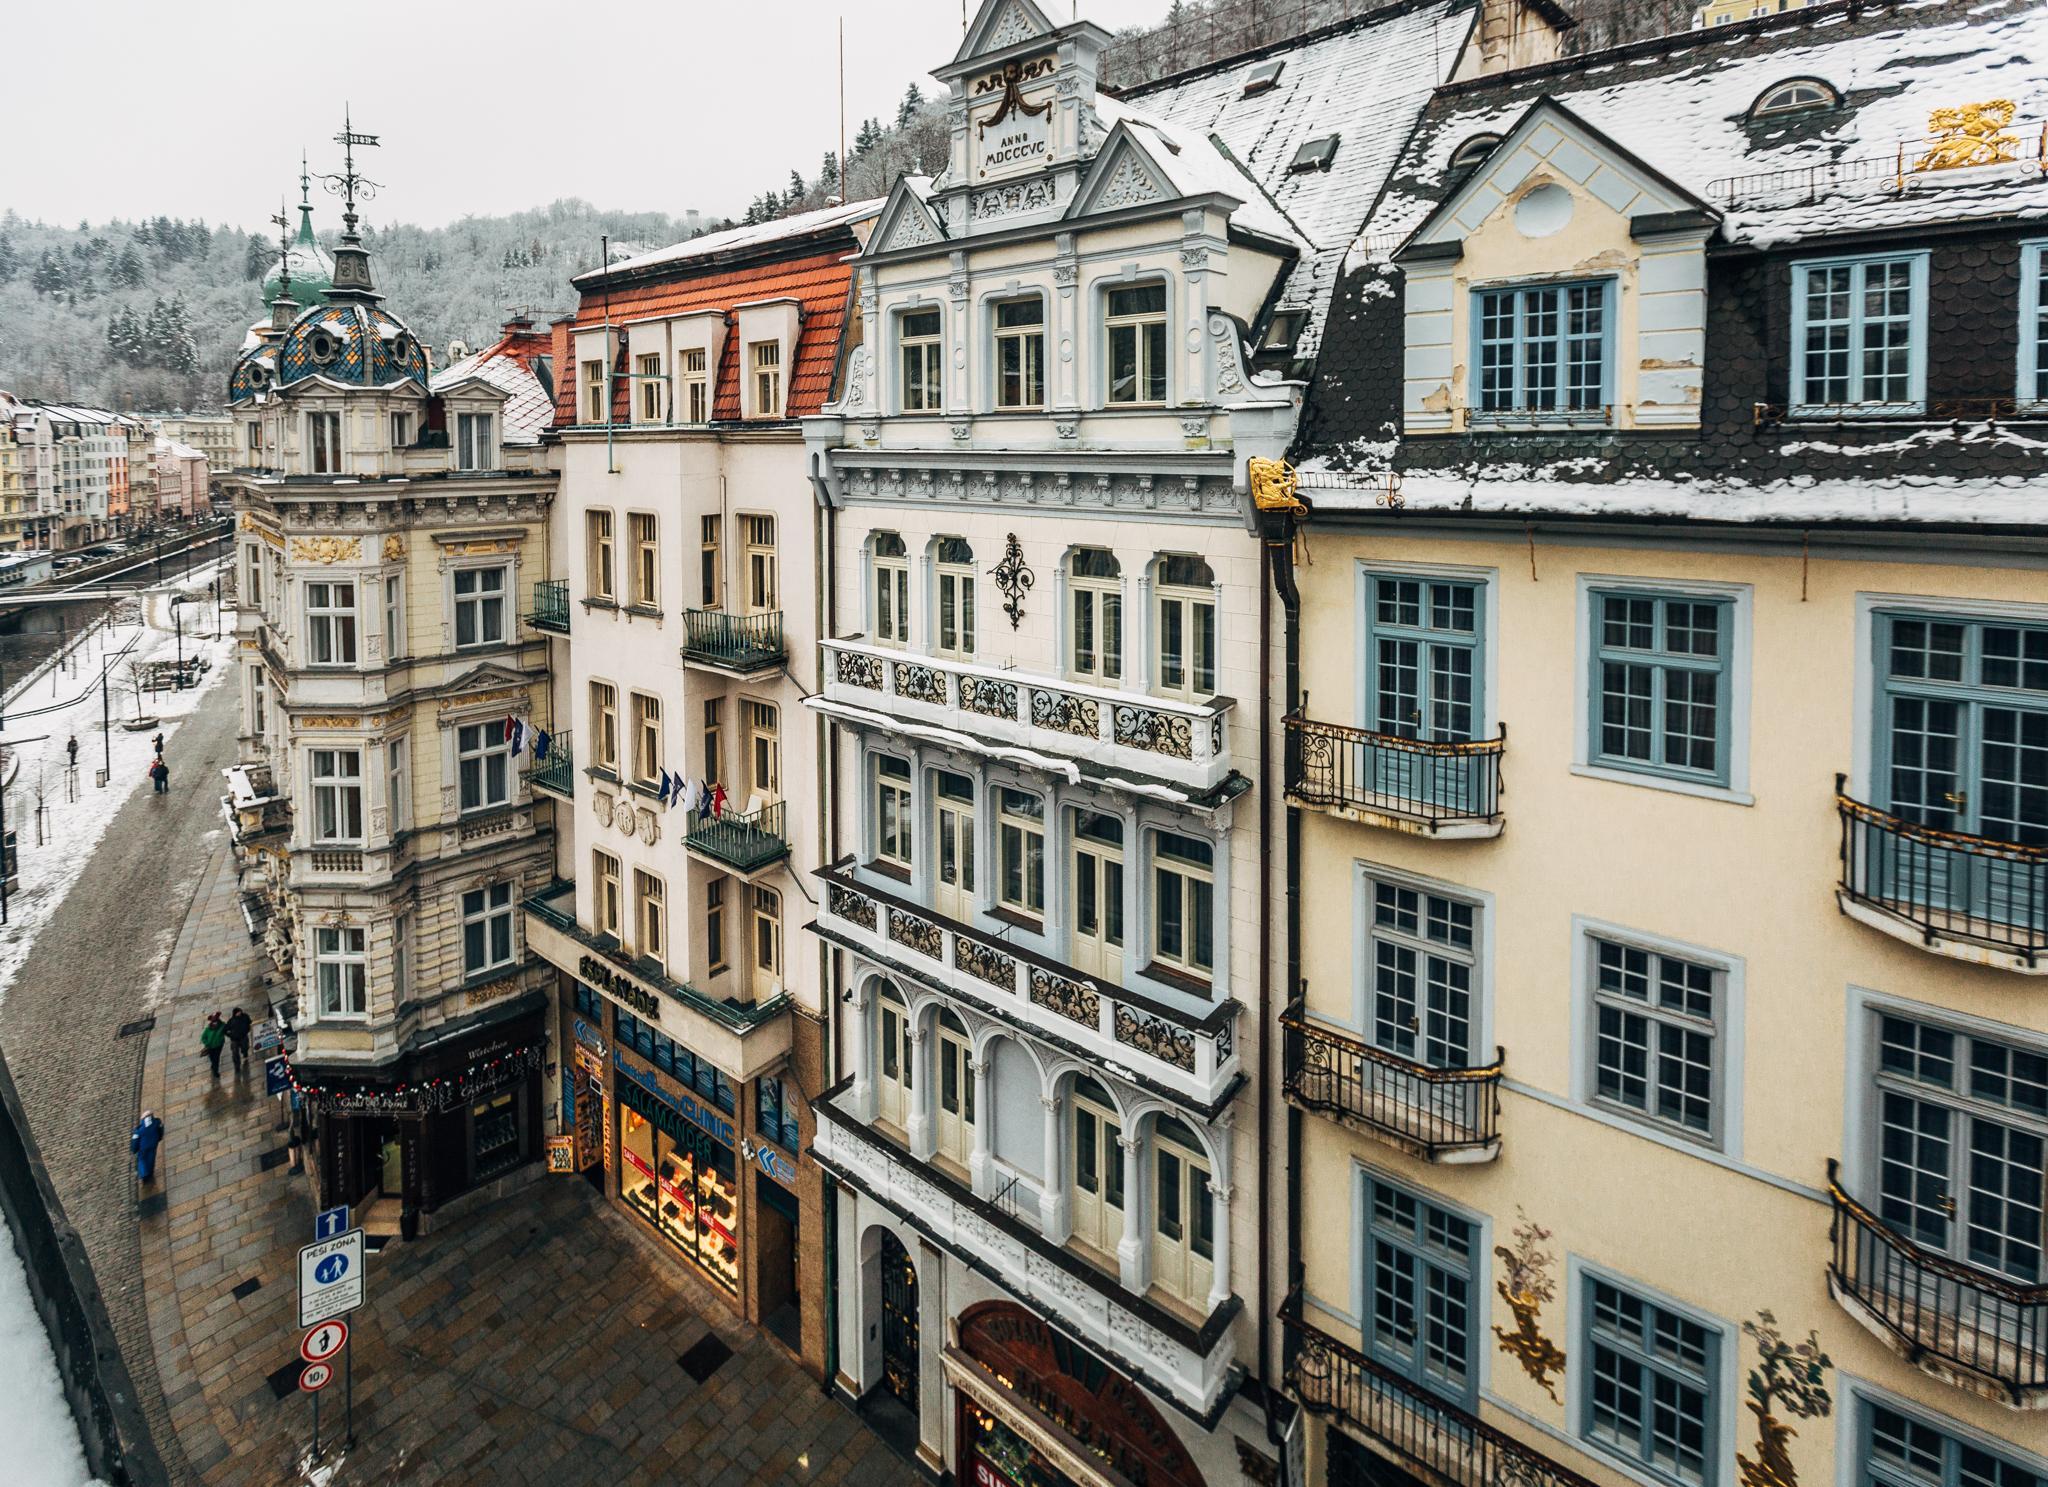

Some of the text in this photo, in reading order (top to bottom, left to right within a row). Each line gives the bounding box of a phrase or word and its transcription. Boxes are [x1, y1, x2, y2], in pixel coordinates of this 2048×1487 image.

[1001, 132, 1028, 148] ANNO
[985, 141, 1045, 166] MDCCCVC
[579, 955, 660, 1020] ESPLANADE
[622, 1082, 712, 1164] SALAMANDER
[681, 1095, 735, 1148] CLINIC
[624, 1148, 635, 1164] SALE
[661, 1177, 673, 1193] SALE
[331, 1236, 356, 1252] ZÓNA
